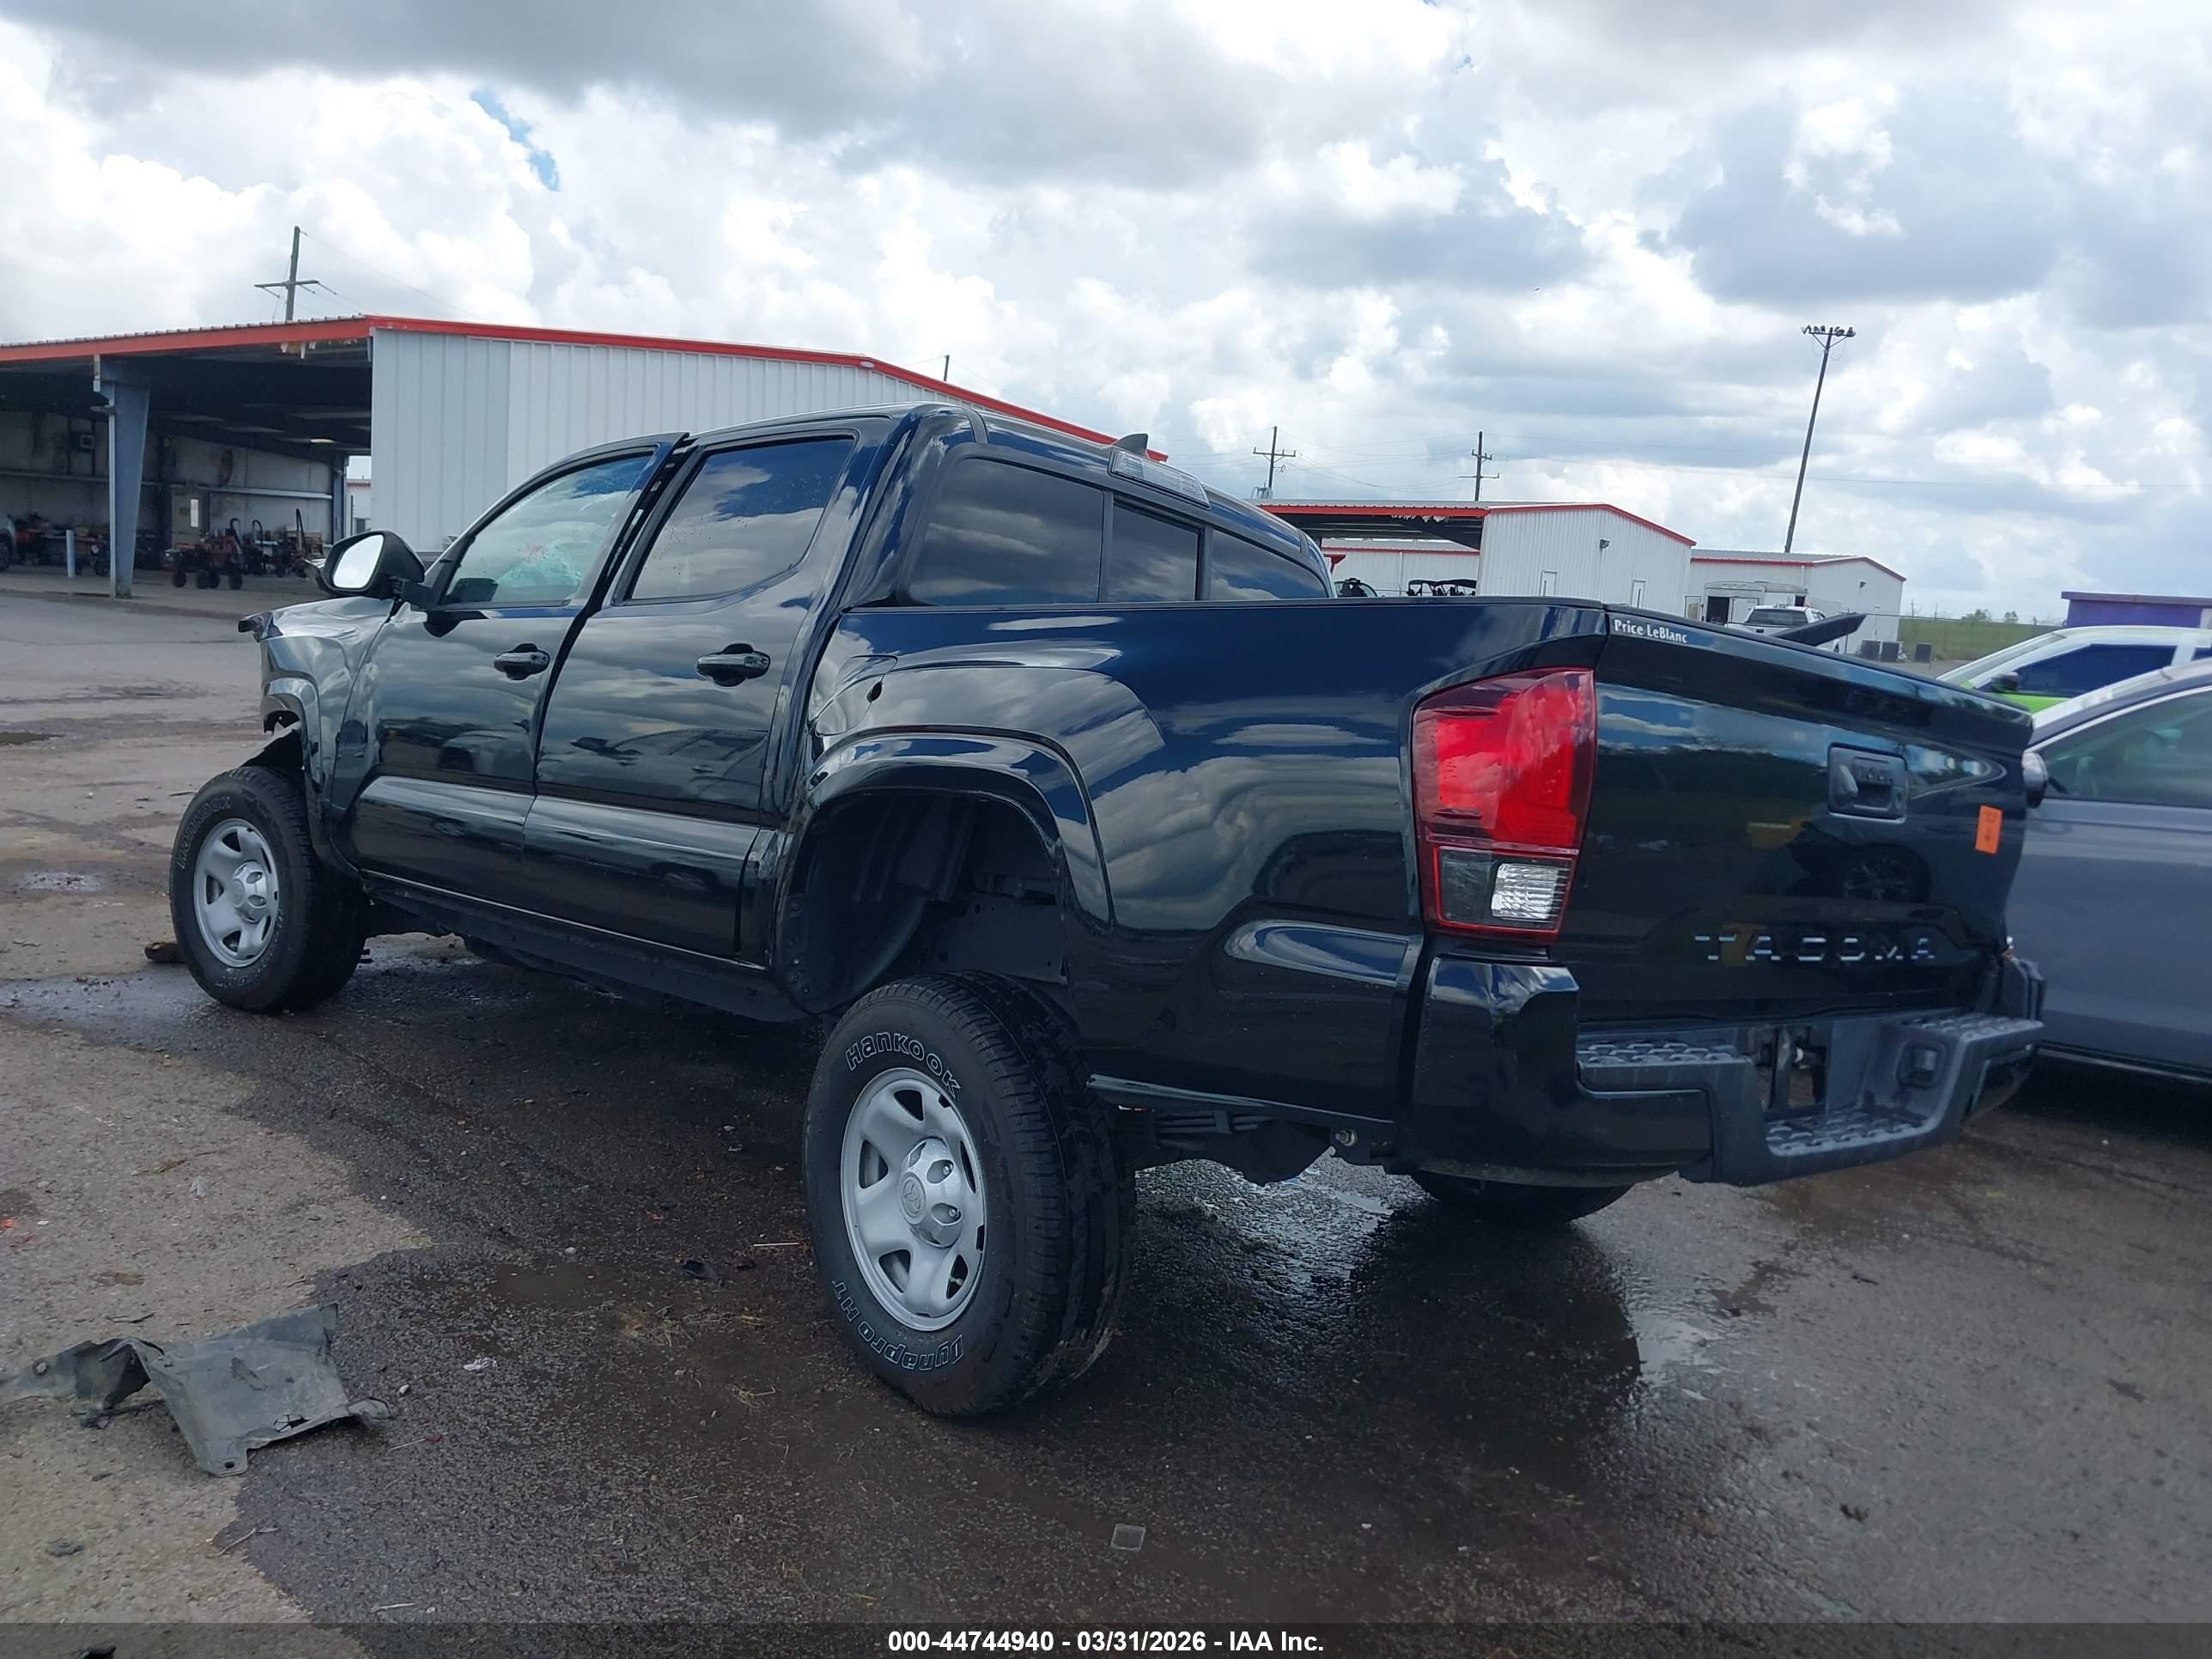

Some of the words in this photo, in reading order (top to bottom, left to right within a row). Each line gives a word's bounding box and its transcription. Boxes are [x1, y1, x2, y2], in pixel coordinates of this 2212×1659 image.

[1613, 619, 1644, 635] Price
[1646, 623, 1688, 643] LeBlanc
[1693, 935, 1936, 961] TACOMA
[858, 1321, 964, 1371] Dynapro
